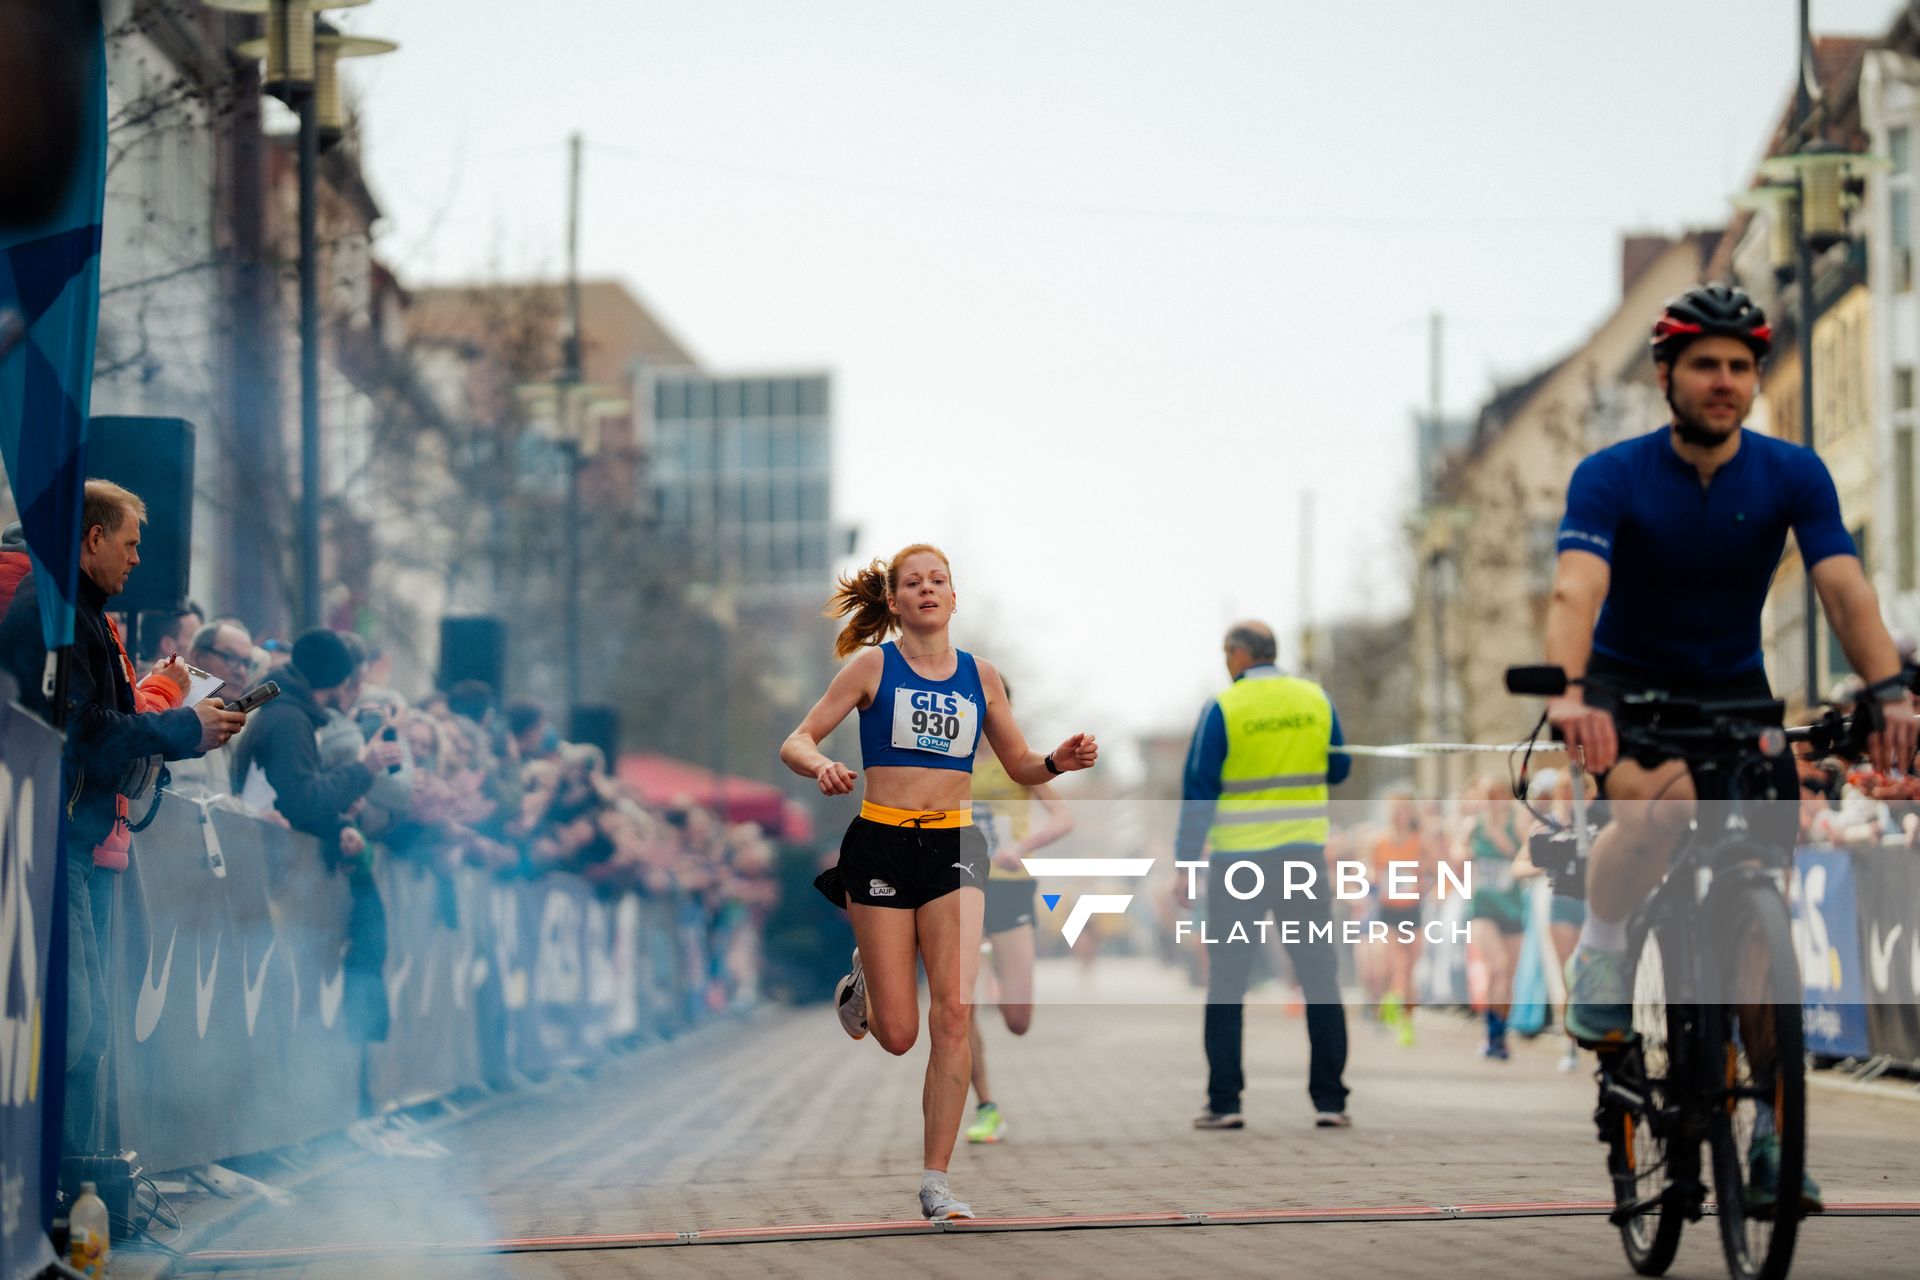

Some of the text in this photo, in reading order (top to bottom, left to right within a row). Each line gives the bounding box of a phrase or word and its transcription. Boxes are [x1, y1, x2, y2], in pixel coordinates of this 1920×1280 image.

[911, 692, 958, 715] GLS
[912, 711, 959, 739] 930
[1243, 713, 1316, 735] ORDNER
[931, 739, 949, 748] PLAN
[873, 887, 894, 895] LAUF
